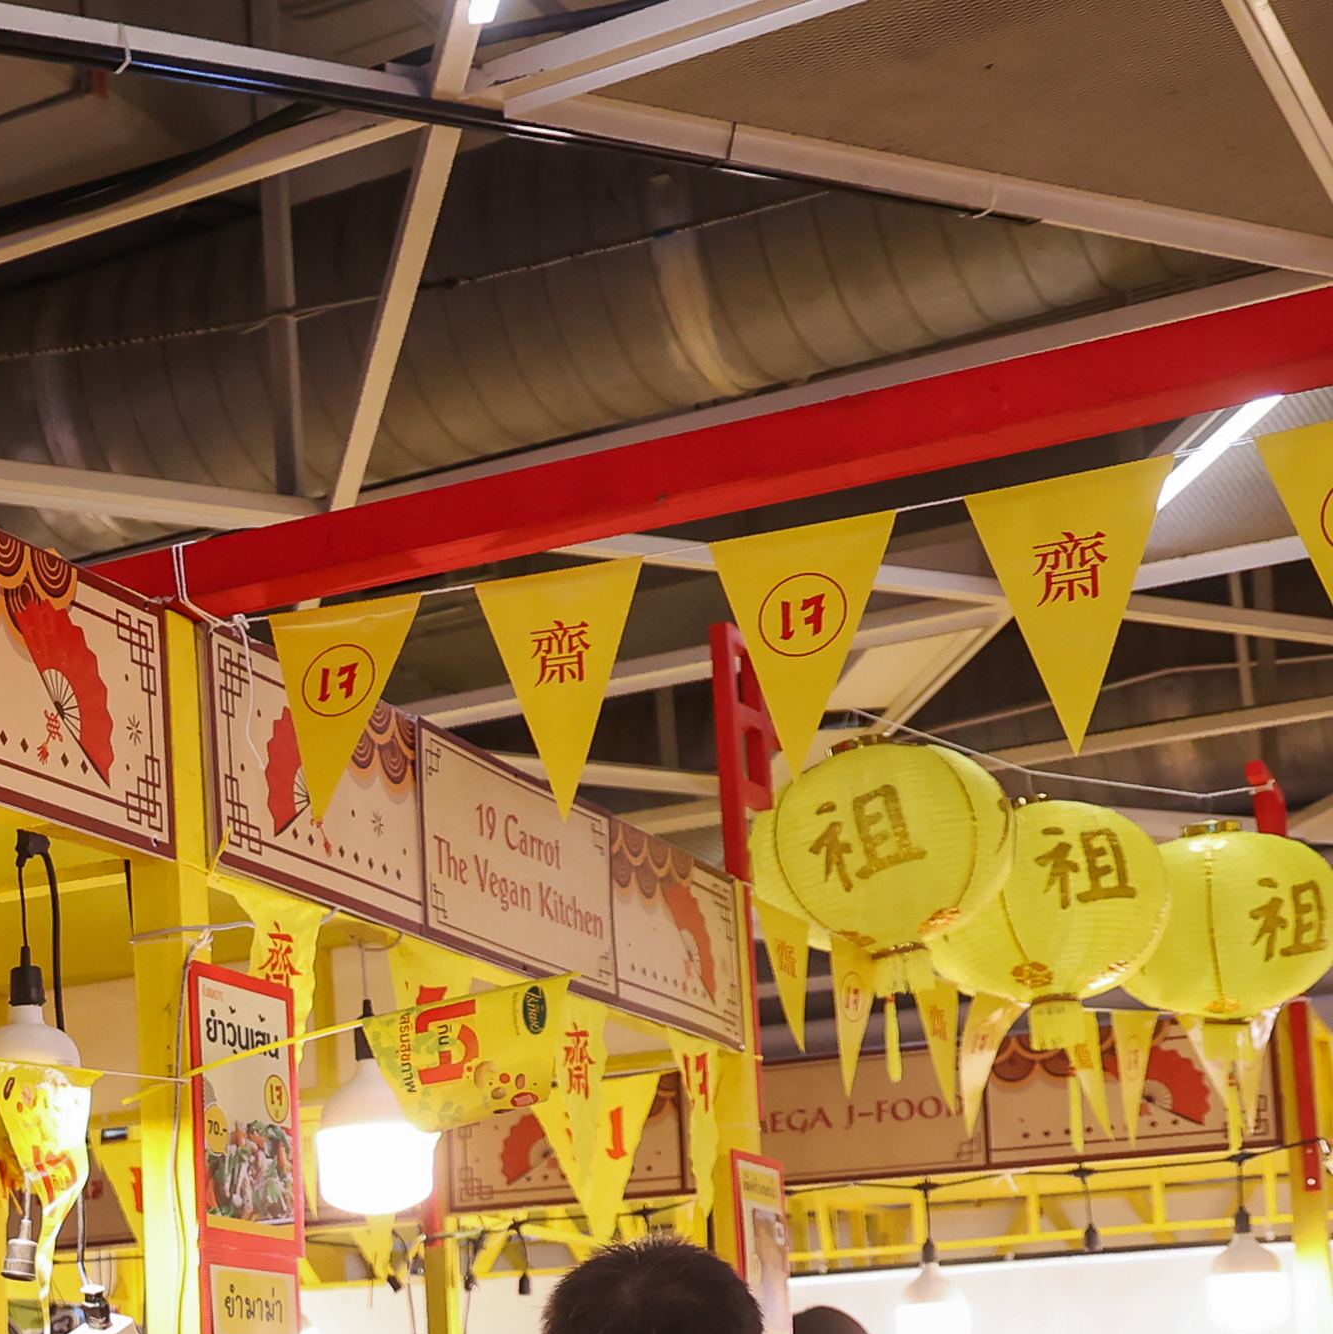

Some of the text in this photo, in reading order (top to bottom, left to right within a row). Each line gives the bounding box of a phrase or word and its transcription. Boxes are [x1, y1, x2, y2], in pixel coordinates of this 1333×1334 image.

[779, 593, 827, 641] เจ
[319, 662, 359, 699] เจ
[475, 804, 562, 871] 19 Carrot
[809, 783, 925, 891] 祖
[433, 835, 605, 940] The Vegan Kitchen
[1035, 827, 1138, 910] 祖
[1249, 879, 1330, 962] 祖
[205, 1005, 279, 1060] ยำวุ้นเส้น
[207, 1119, 228, 1136] 70.-
[224, 1284, 283, 1324] ยำมาม่า
